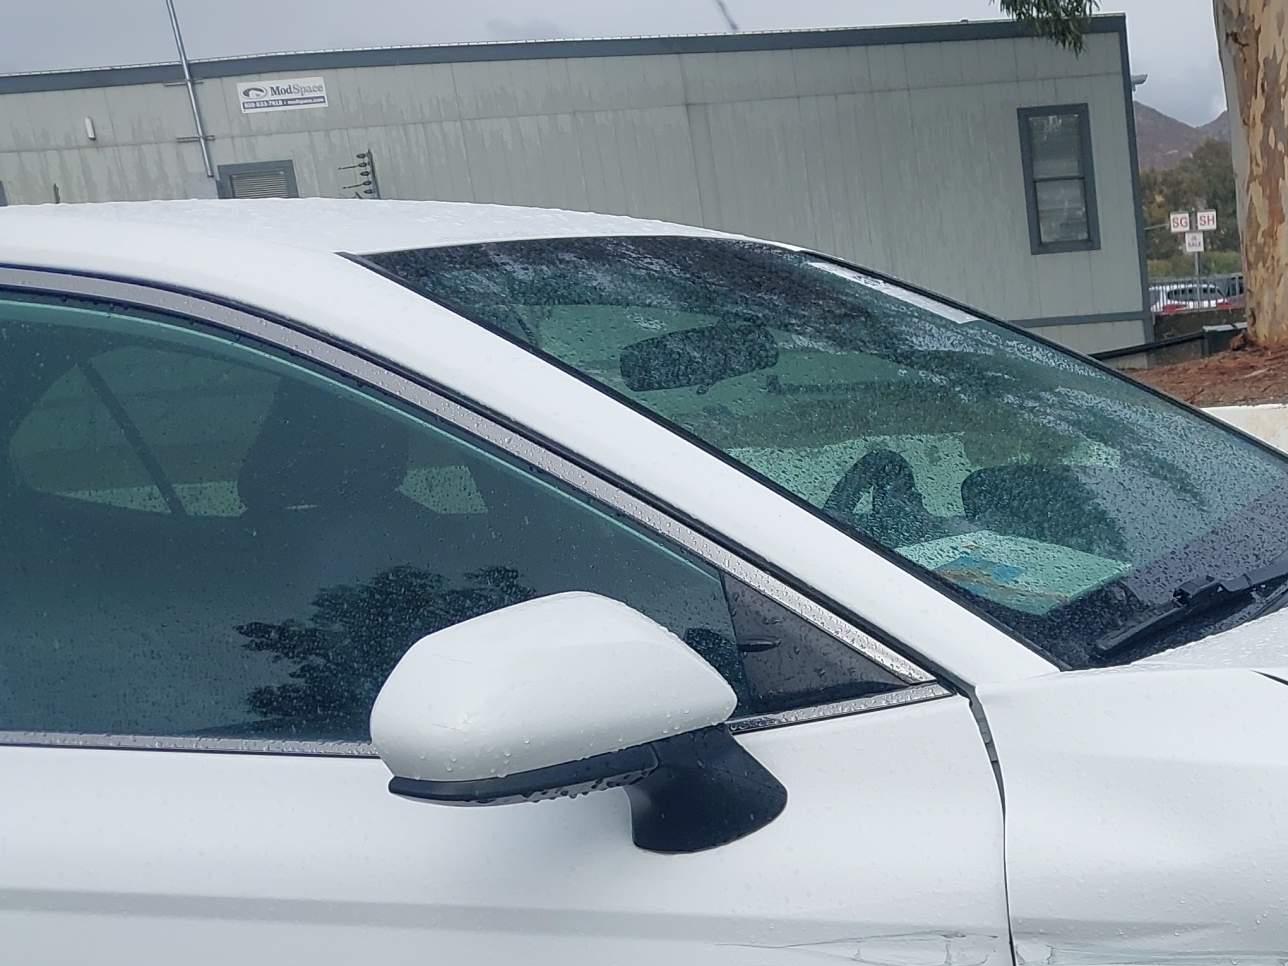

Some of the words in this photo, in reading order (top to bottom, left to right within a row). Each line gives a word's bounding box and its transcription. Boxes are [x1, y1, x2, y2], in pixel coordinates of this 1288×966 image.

[269, 84, 323, 97] ModSpace
[1172, 216, 1188, 228] SG
[1199, 214, 1215, 226] SH
